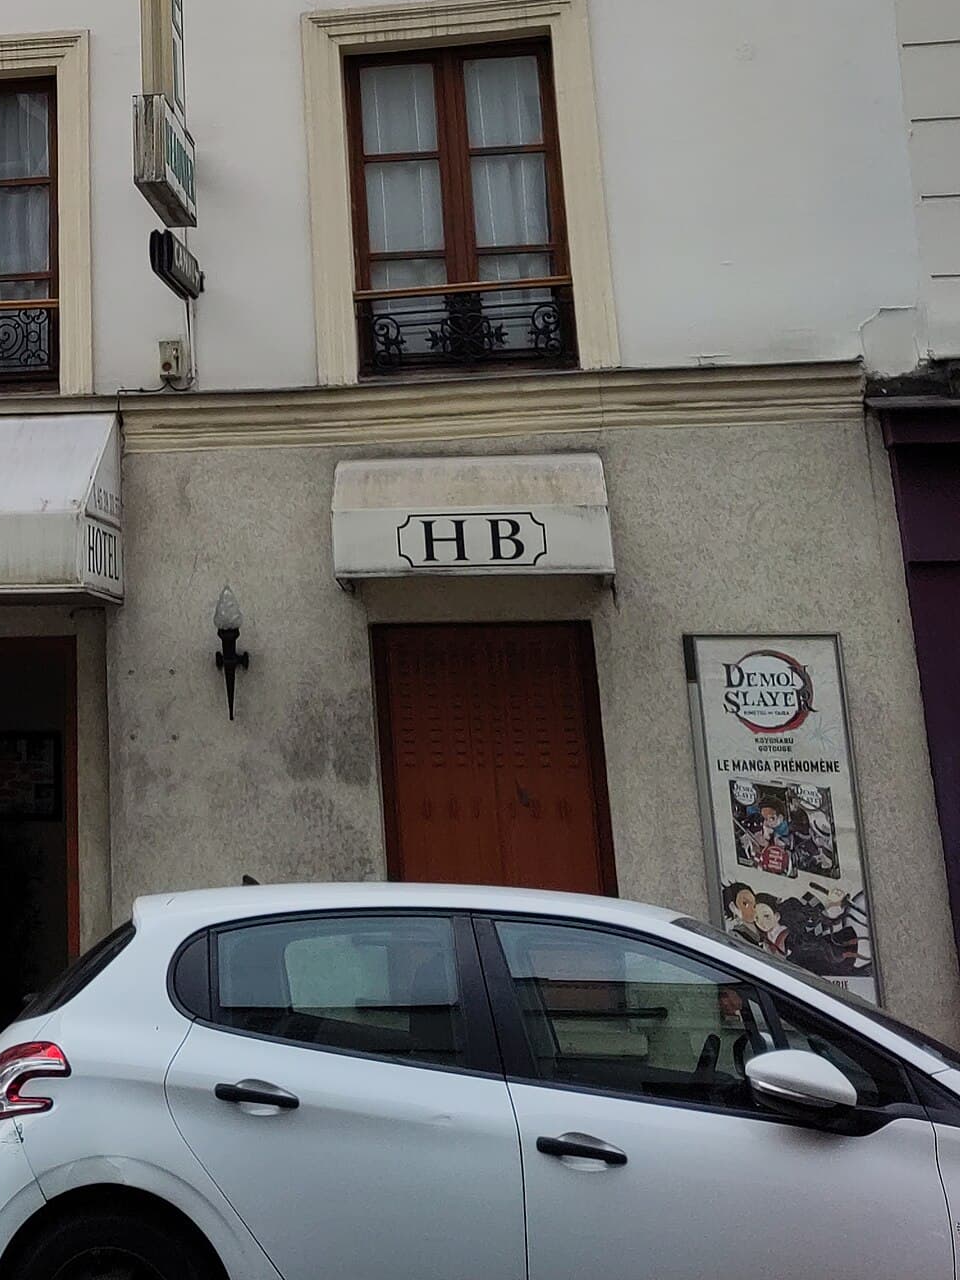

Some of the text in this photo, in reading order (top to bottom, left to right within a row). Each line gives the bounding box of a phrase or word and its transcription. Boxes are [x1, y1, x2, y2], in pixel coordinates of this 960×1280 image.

[88, 524, 119, 580] HOTEL
[722, 663, 809, 689] DEMON
[723, 687, 818, 714] SLAYER
[717, 757, 840, 773] LE MANGA PHÉNOMÈNE
